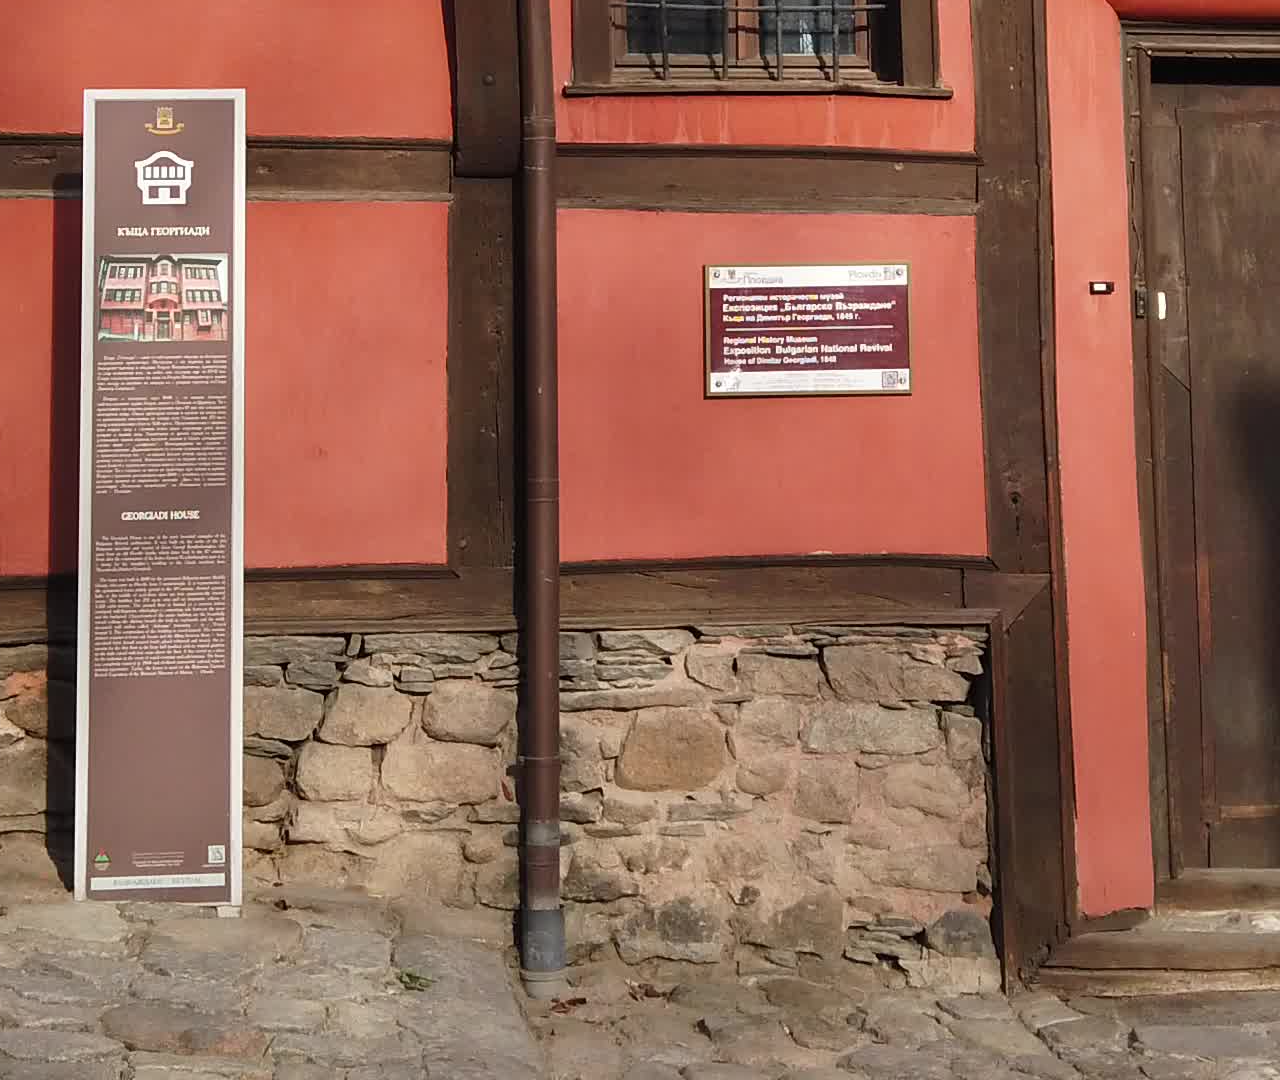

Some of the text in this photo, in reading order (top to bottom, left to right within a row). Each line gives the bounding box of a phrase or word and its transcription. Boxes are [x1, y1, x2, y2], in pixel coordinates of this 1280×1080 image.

[117, 226, 210, 237] КЪЩА ГЕОРГИАДИ
[722, 303, 778, 313] Експозиция
[723, 336, 757, 345] Regional
[757, 336, 785, 345] History
[723, 343, 893, 356] Exposition Bulgarian National Revival
[121, 510, 200, 521] GEORGIADI HOUSE
